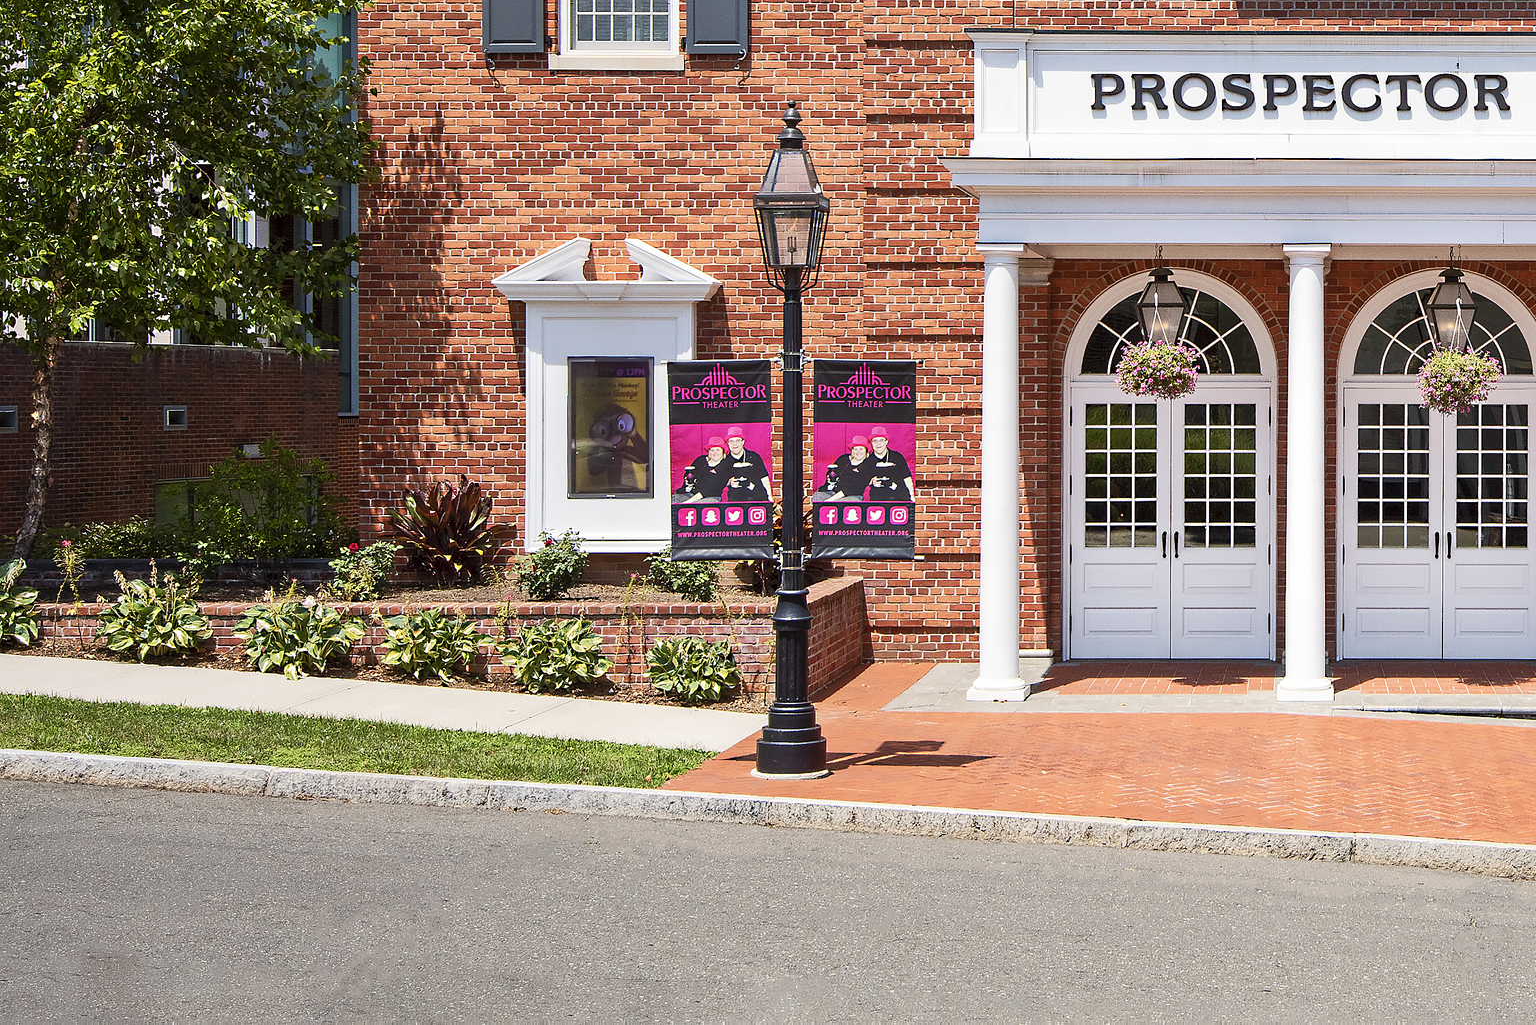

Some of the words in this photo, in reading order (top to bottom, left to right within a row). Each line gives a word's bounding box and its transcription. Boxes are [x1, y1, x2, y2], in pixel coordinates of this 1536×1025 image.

[1090, 73, 1511, 112] PROSPECTOR
[672, 384, 767, 400] PROSPECTOR
[818, 384, 912, 399] PROSPECTOR
[702, 401, 739, 409] THEATER
[847, 400, 884, 408] THEATER
[677, 530, 768, 538] WWW.PROSPECTORTHEATER.ORG
